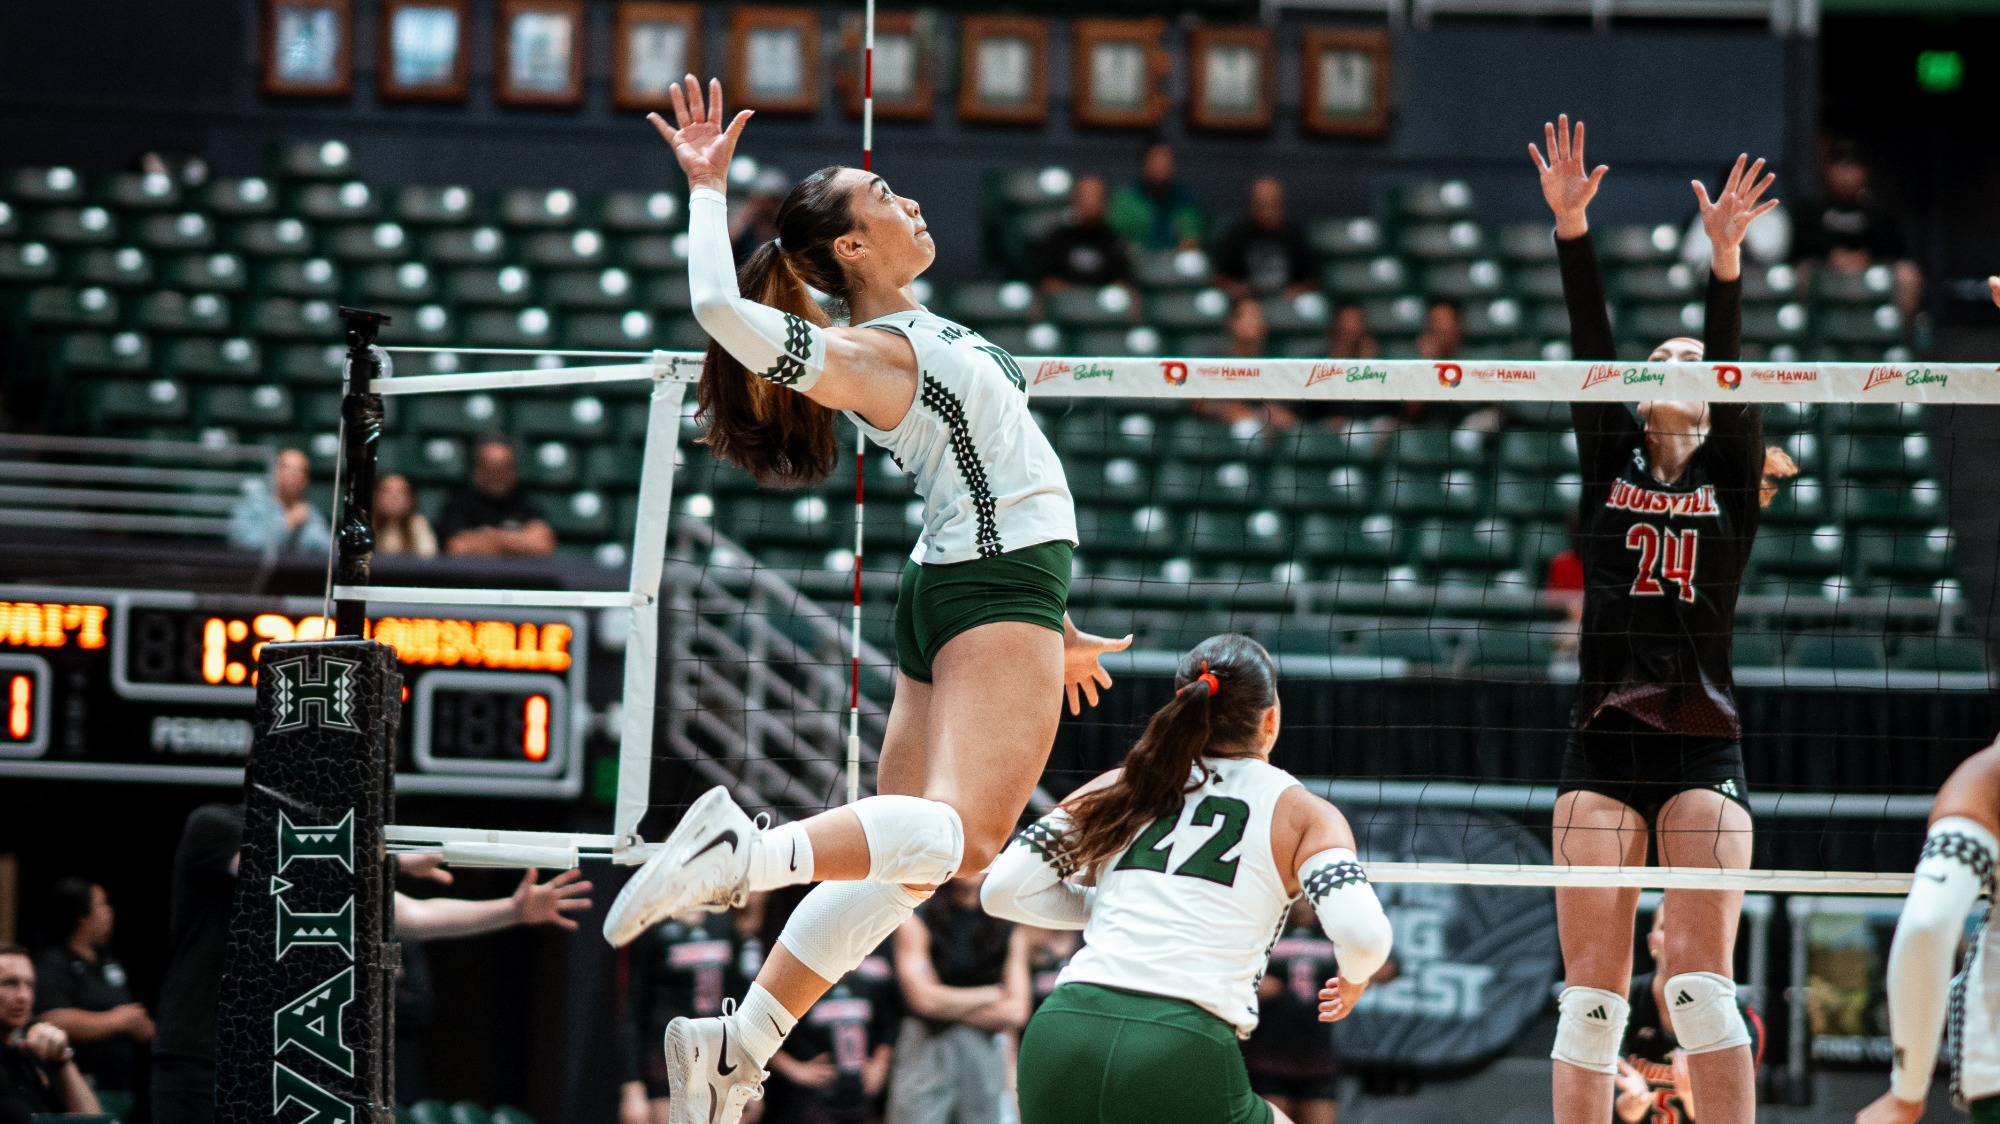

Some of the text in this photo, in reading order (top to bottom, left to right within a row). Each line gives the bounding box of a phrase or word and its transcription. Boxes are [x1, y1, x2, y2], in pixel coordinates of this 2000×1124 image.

[1073, 364, 1114, 381] Bakery
[1221, 367, 1260, 378] HAWAII
[1346, 365, 1387, 383] Bakery
[1497, 369, 1536, 380] HAWAII
[1623, 367, 1665, 386] Bakery
[1776, 370, 1817, 382] HAWAII
[1863, 365, 1948, 391] Liliha Bakery
[1626, 523, 1698, 603] 24
[10, 674, 32, 739] 1
[268, 656, 361, 735] H
[524, 694, 549, 762] 1
[1113, 795, 1250, 888] 22
